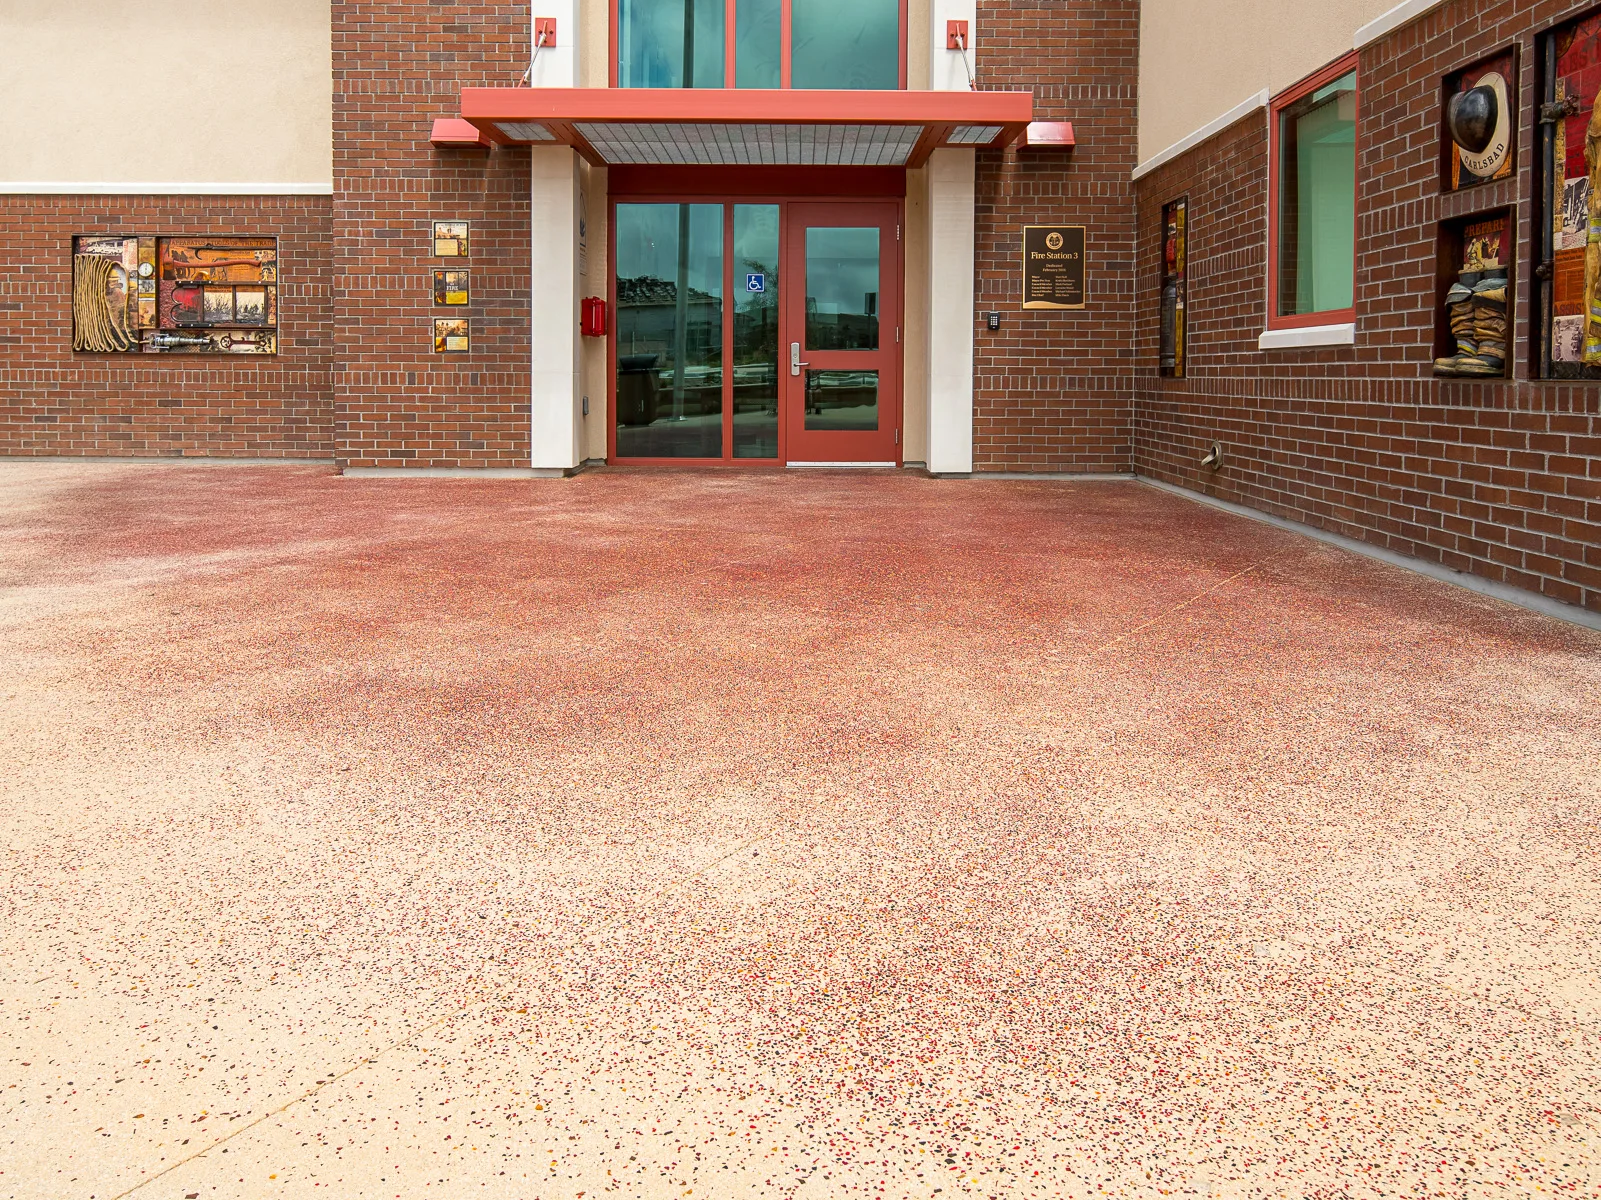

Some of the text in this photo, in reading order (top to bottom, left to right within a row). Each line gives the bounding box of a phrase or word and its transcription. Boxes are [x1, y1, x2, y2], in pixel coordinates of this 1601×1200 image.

[1464, 143, 1505, 170] CARLSBAD
[1031, 251, 1046, 259] Fire
[1046, 251, 1072, 259] Station
